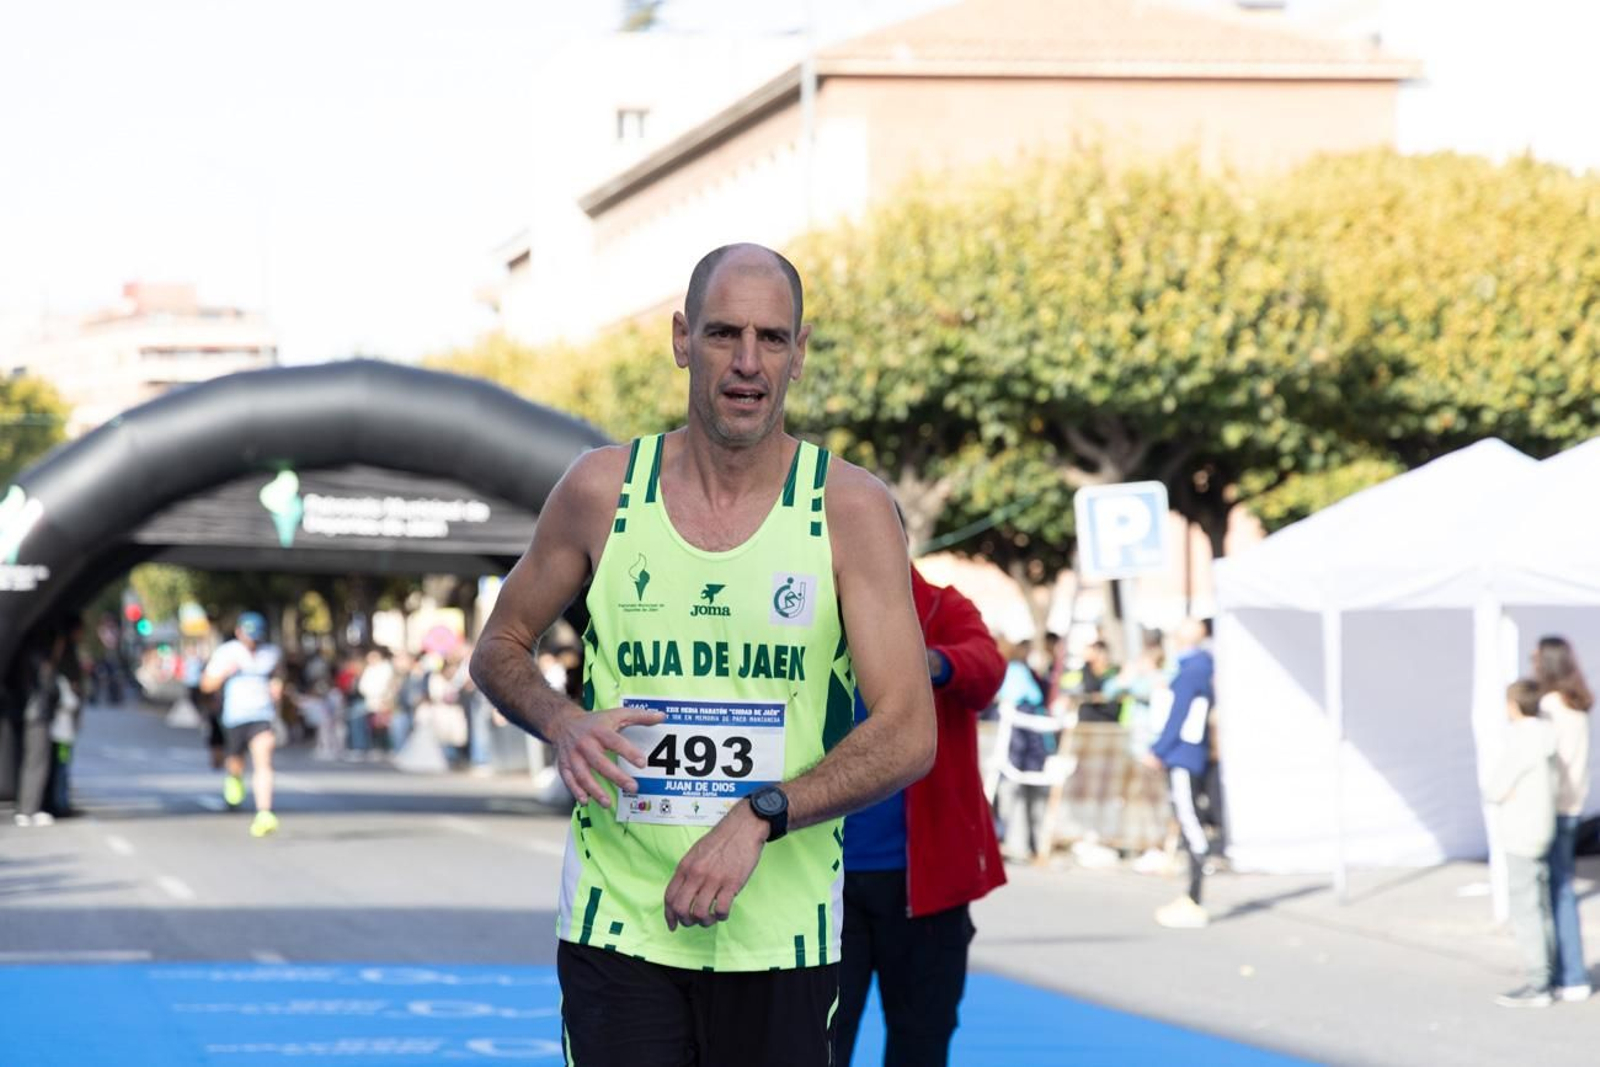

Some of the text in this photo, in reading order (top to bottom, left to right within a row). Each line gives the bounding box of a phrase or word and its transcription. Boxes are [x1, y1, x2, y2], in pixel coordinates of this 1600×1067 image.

[1094, 494, 1152, 568] P
[617, 640, 807, 681] CAJA DE JAEN
[647, 733, 754, 779] 493
[664, 781, 736, 792] JUAN DE DIOS
